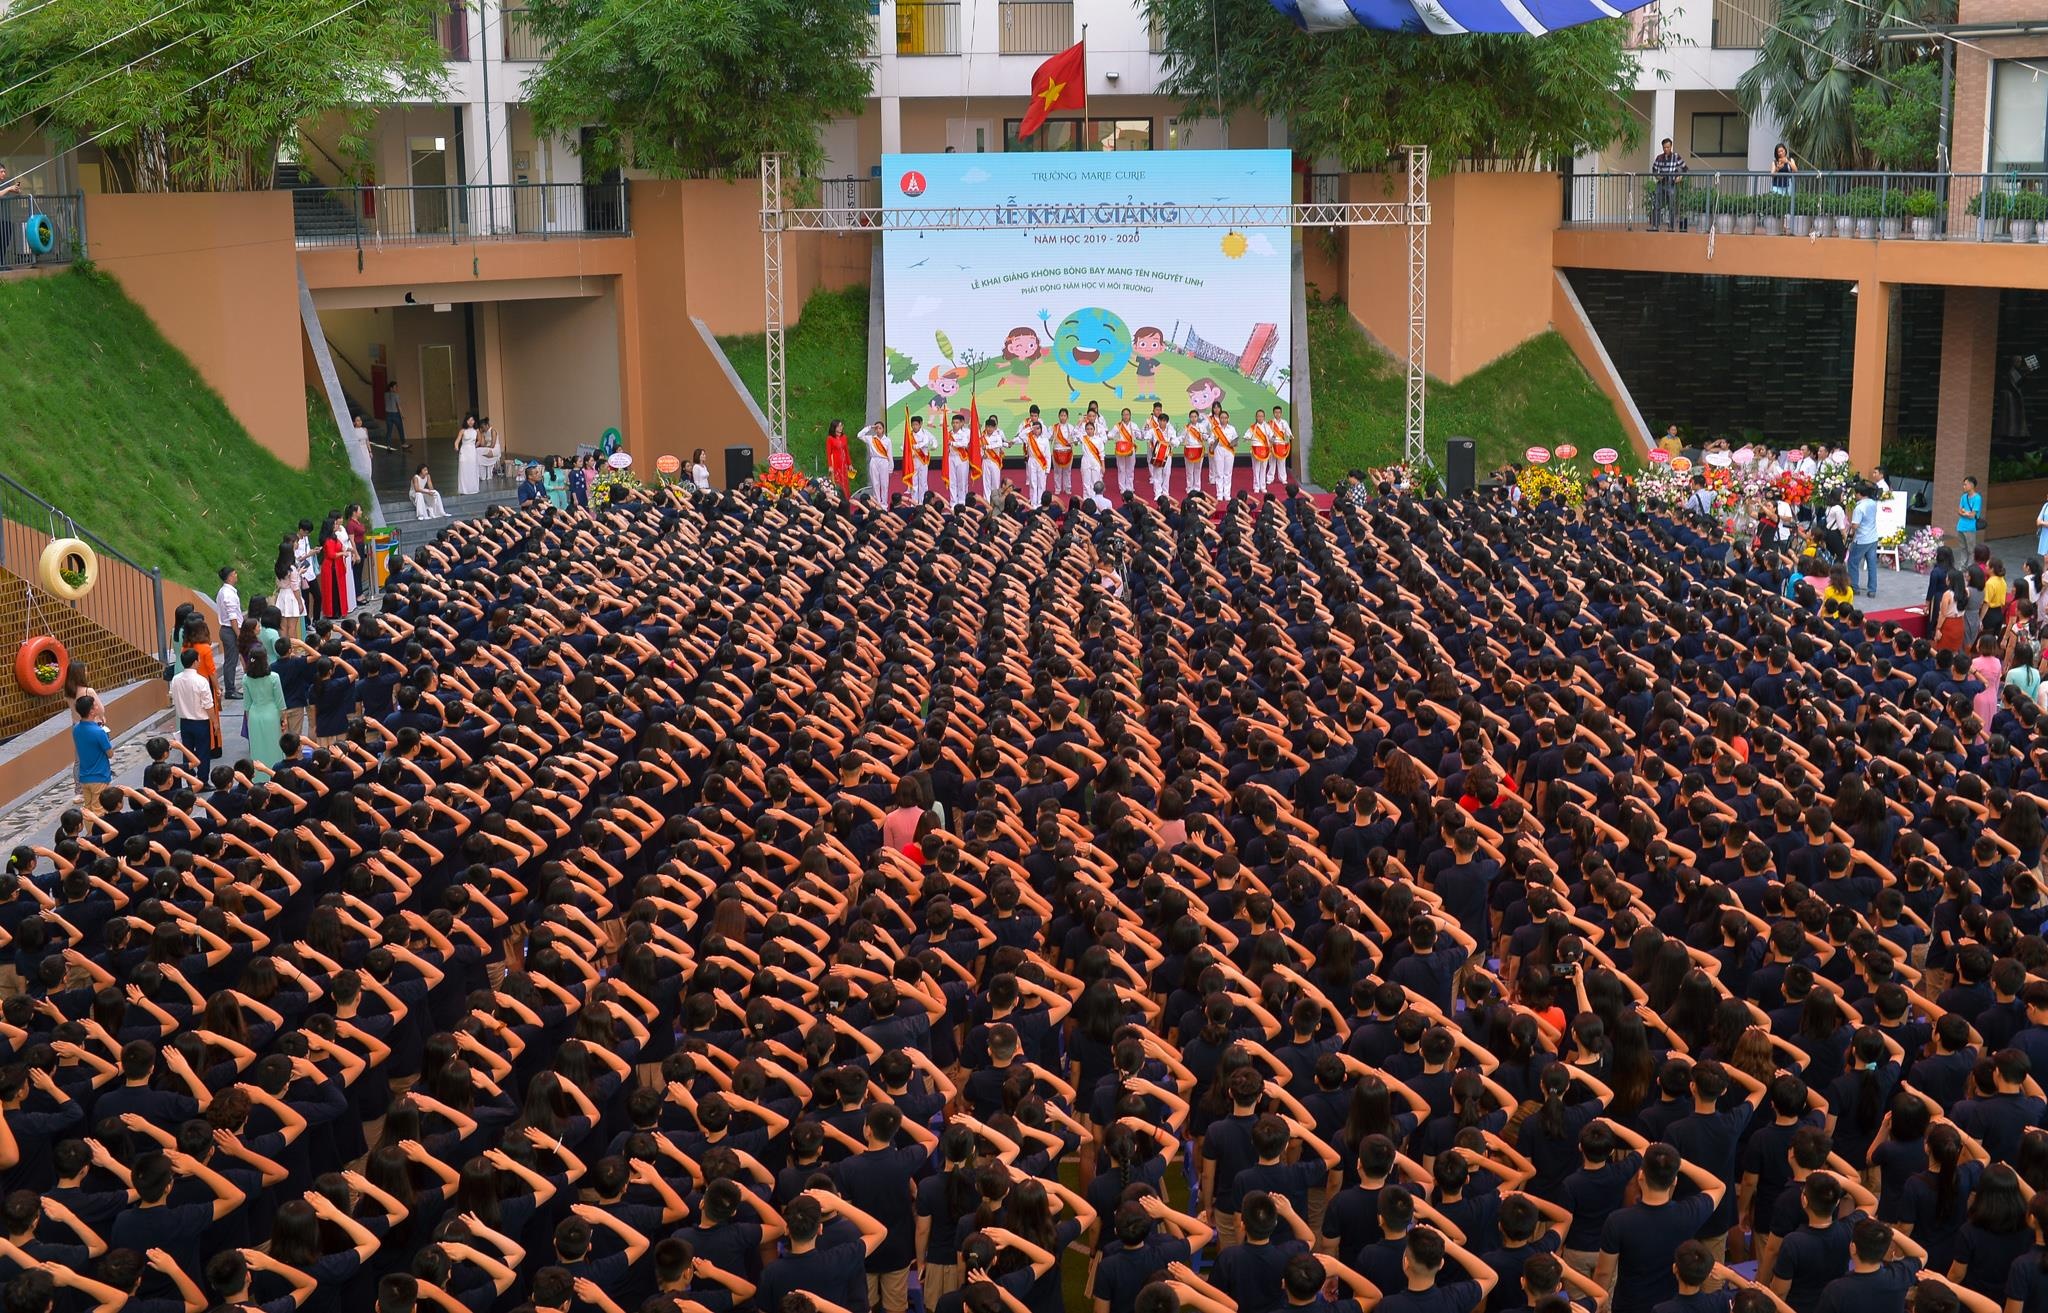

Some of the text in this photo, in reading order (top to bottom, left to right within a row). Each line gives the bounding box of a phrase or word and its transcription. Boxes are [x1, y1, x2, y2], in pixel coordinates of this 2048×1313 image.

[1081, 171, 1112, 181] MARIE
[1115, 171, 1146, 181] CURIE
[996, 194, 1178, 225] LỄ KHAI GIẢNG
[1060, 234, 1081, 245] HỌC
[1084, 234, 1107, 243] 2019
[1116, 234, 1140, 243] 2020
[982, 277, 1001, 287] KHAI
[1003, 271, 1029, 283] GIẢNG
[1031, 267, 1061, 278] KHÔNG
[1089, 266, 1105, 275] BAY
[1107, 267, 1133, 276] MANG
[1135, 268, 1150, 278] TÊN
[1184, 276, 1204, 288] LINH
[1081, 281, 1097, 290] HỌC
